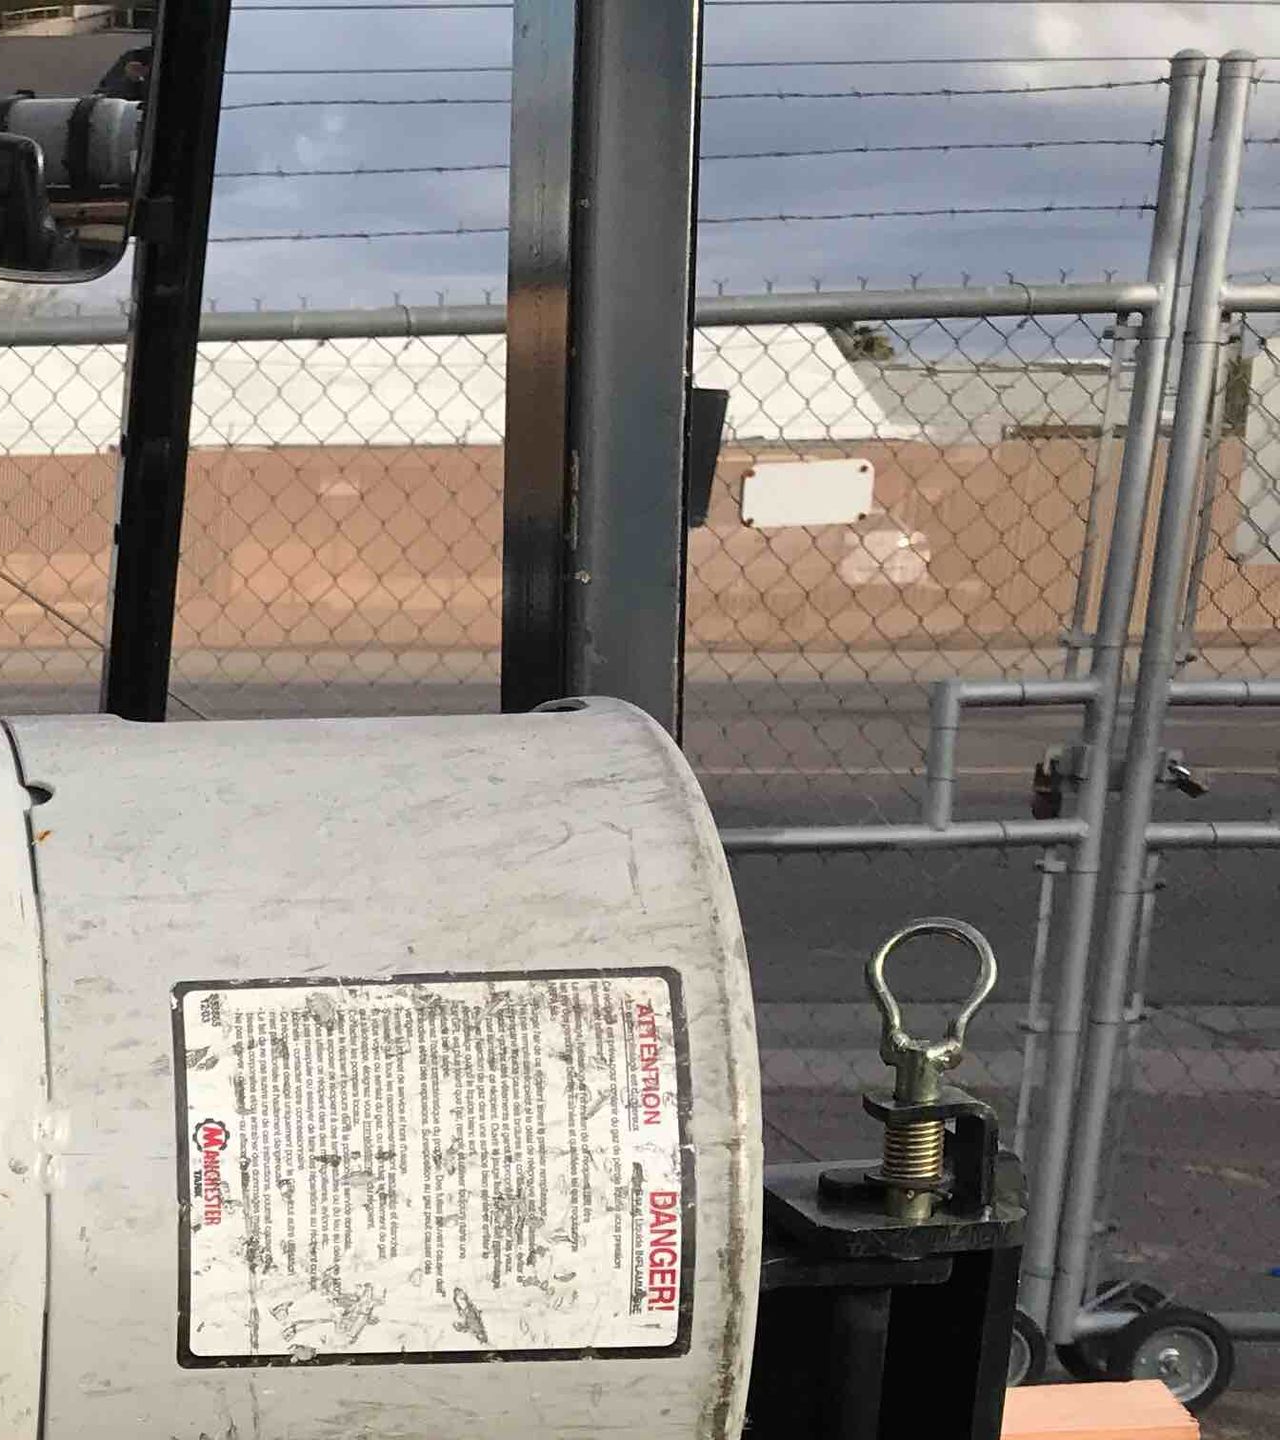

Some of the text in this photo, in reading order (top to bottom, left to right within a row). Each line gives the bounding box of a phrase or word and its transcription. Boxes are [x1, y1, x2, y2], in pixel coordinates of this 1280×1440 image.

[635, 1003, 661, 1125] ATTENTION
[194, 1169, 203, 1198] TANK
[202, 1127, 224, 1227] MANCHESTER
[648, 1191, 680, 1312] DANGER!
